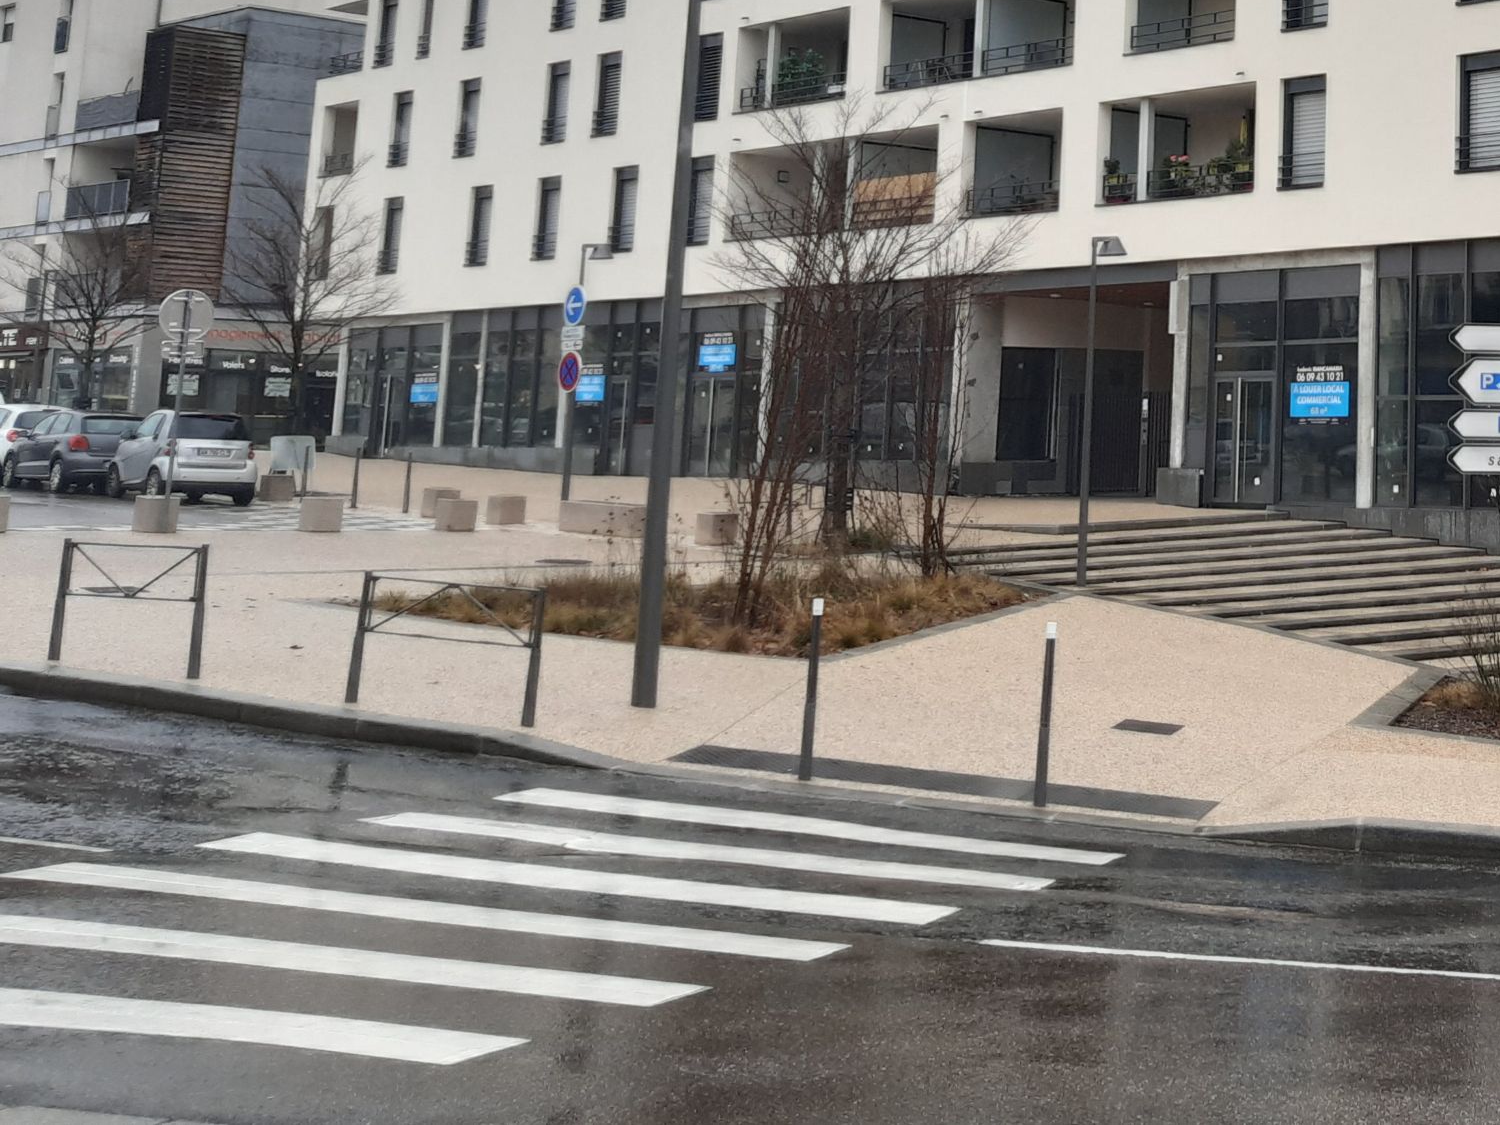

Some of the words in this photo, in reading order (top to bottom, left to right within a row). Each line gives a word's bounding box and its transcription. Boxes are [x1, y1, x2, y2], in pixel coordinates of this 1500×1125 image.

[1296, 372, 1305, 381] 06
[1306, 372, 1315, 381] 09
[1315, 372, 1324, 381] 43
[1326, 372, 1334, 381] 10
[1335, 371, 1344, 381] 21
[1300, 385, 1321, 393] LOUER
[1322, 385, 1344, 393] LOCAL
[1296, 395, 1341, 404] COMMERCIAL
